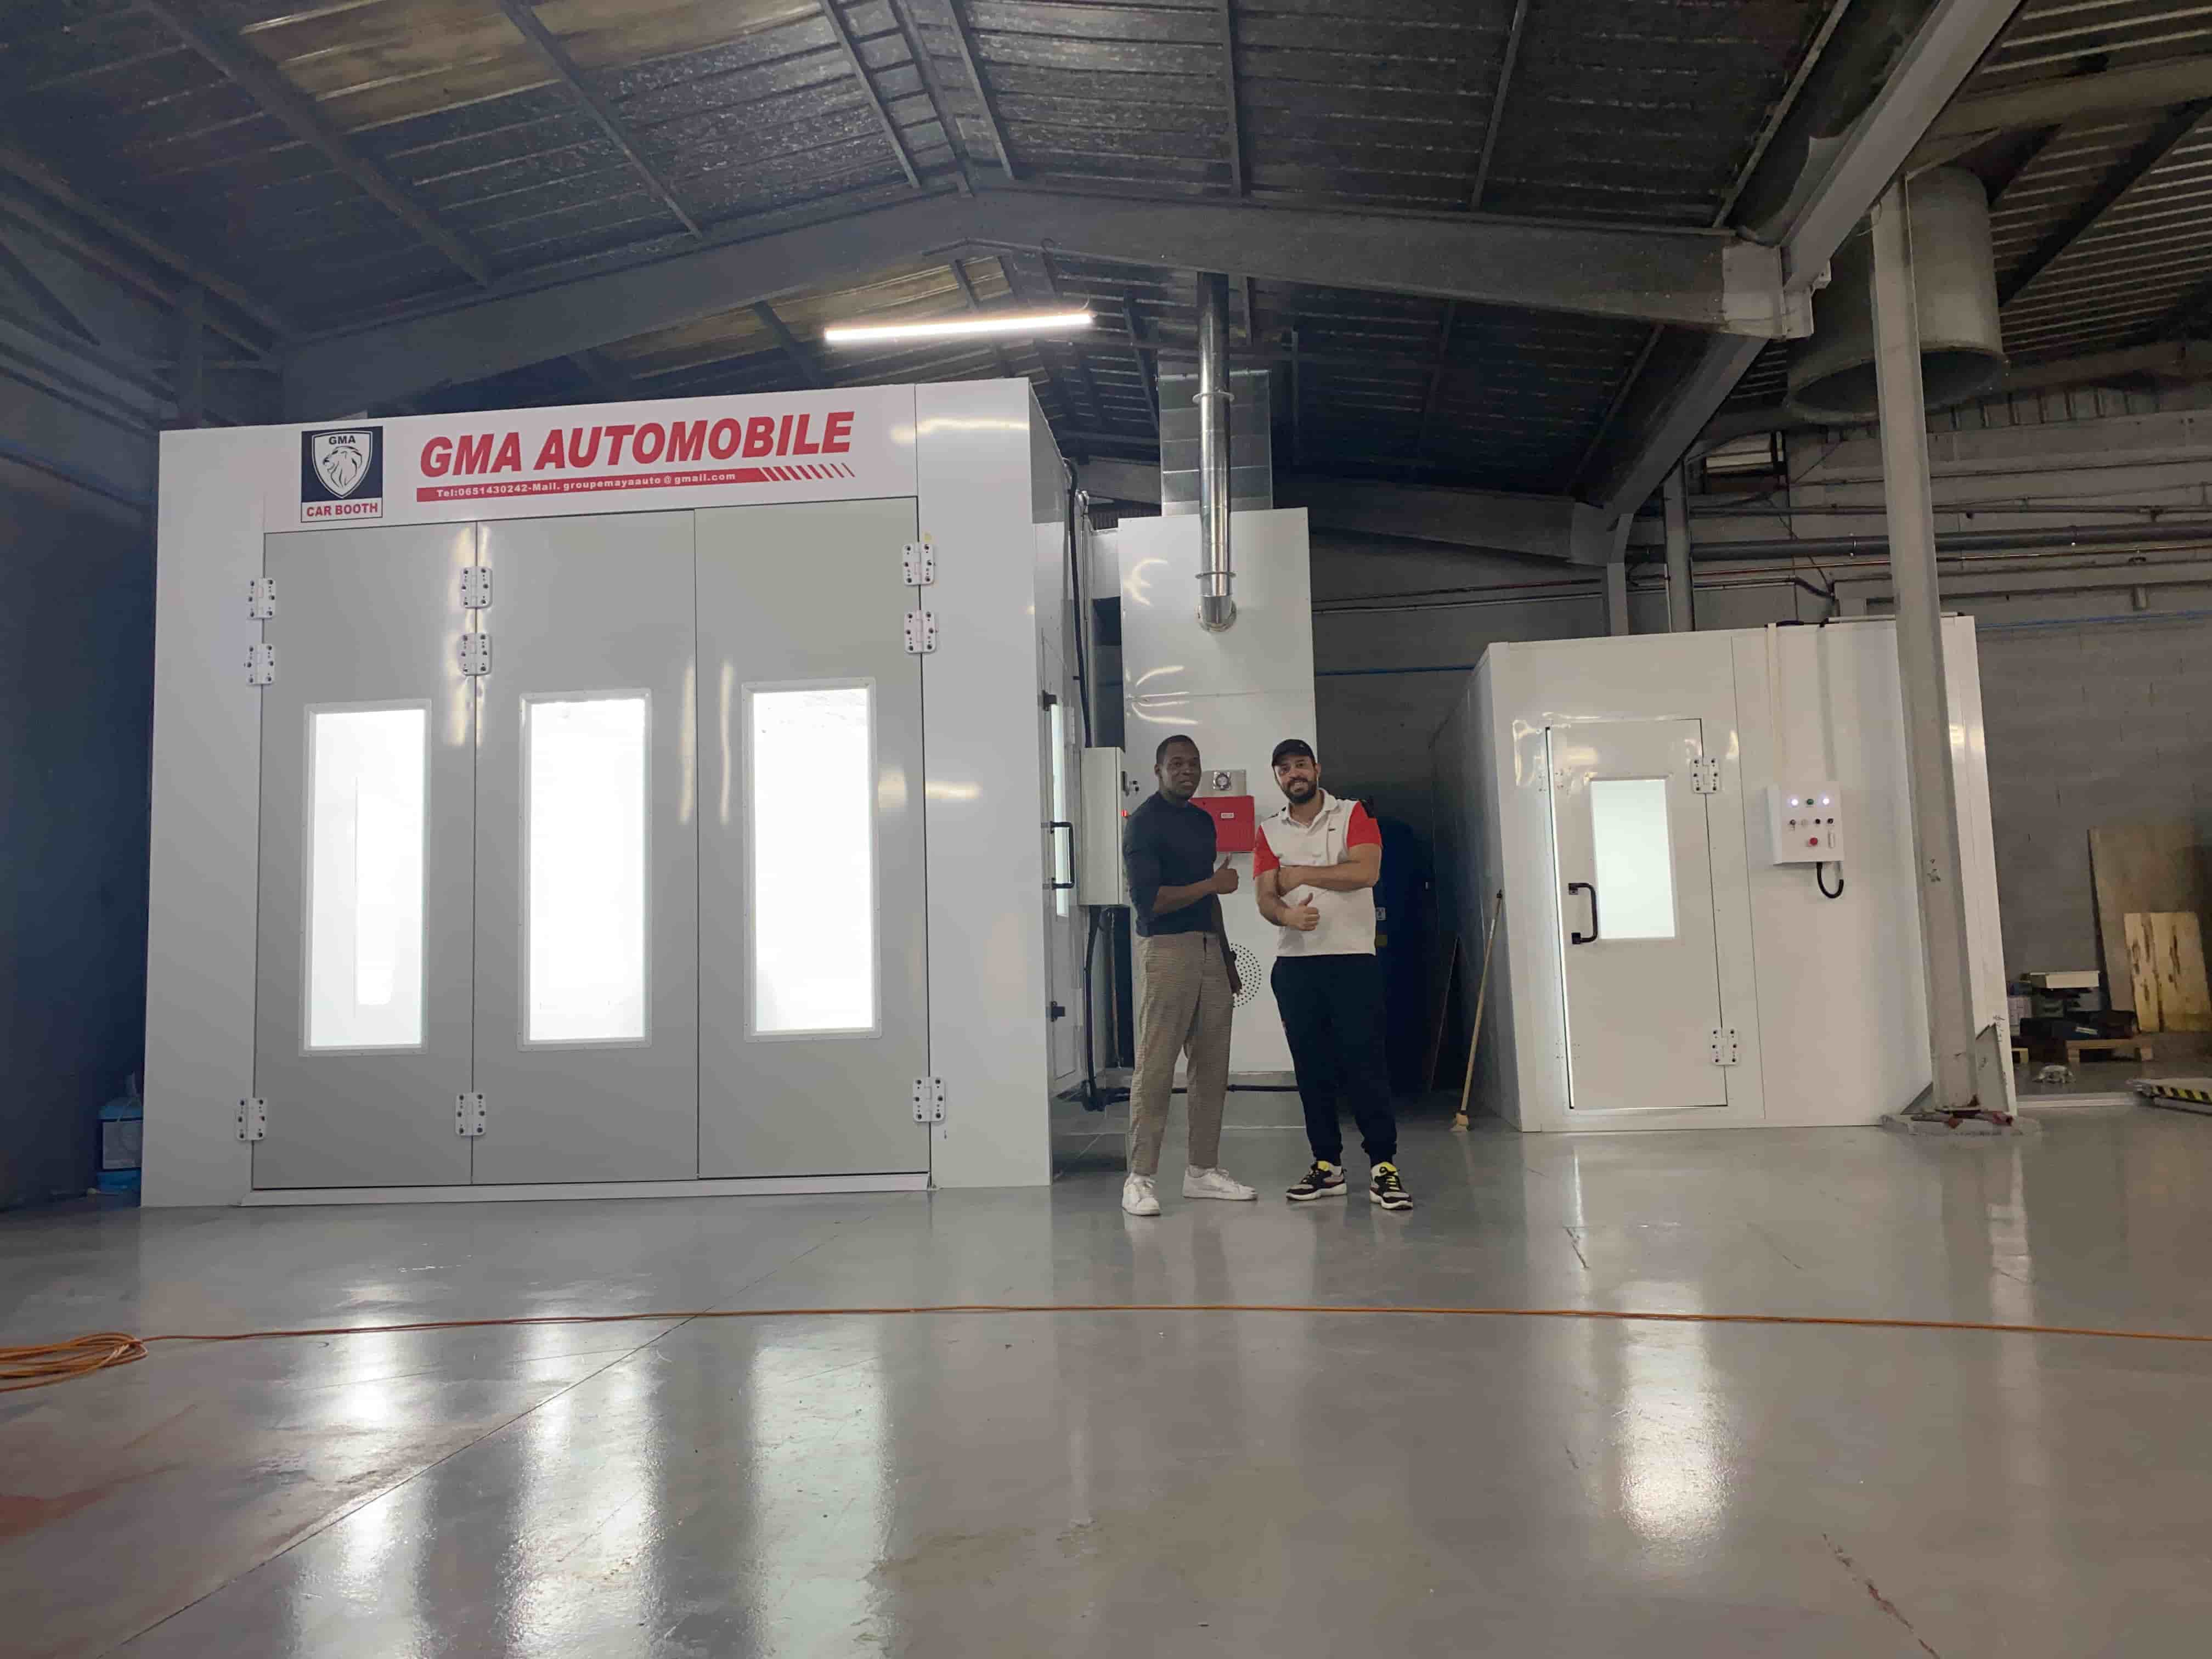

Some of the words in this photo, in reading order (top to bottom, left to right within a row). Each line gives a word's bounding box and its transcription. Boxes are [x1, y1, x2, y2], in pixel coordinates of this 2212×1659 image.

[329, 435, 356, 445] GMA
[421, 433, 521, 477] GMA
[533, 411, 854, 470] AUTOMOBILE
[307, 505, 332, 517] CAR
[335, 503, 378, 515] BOOTH
